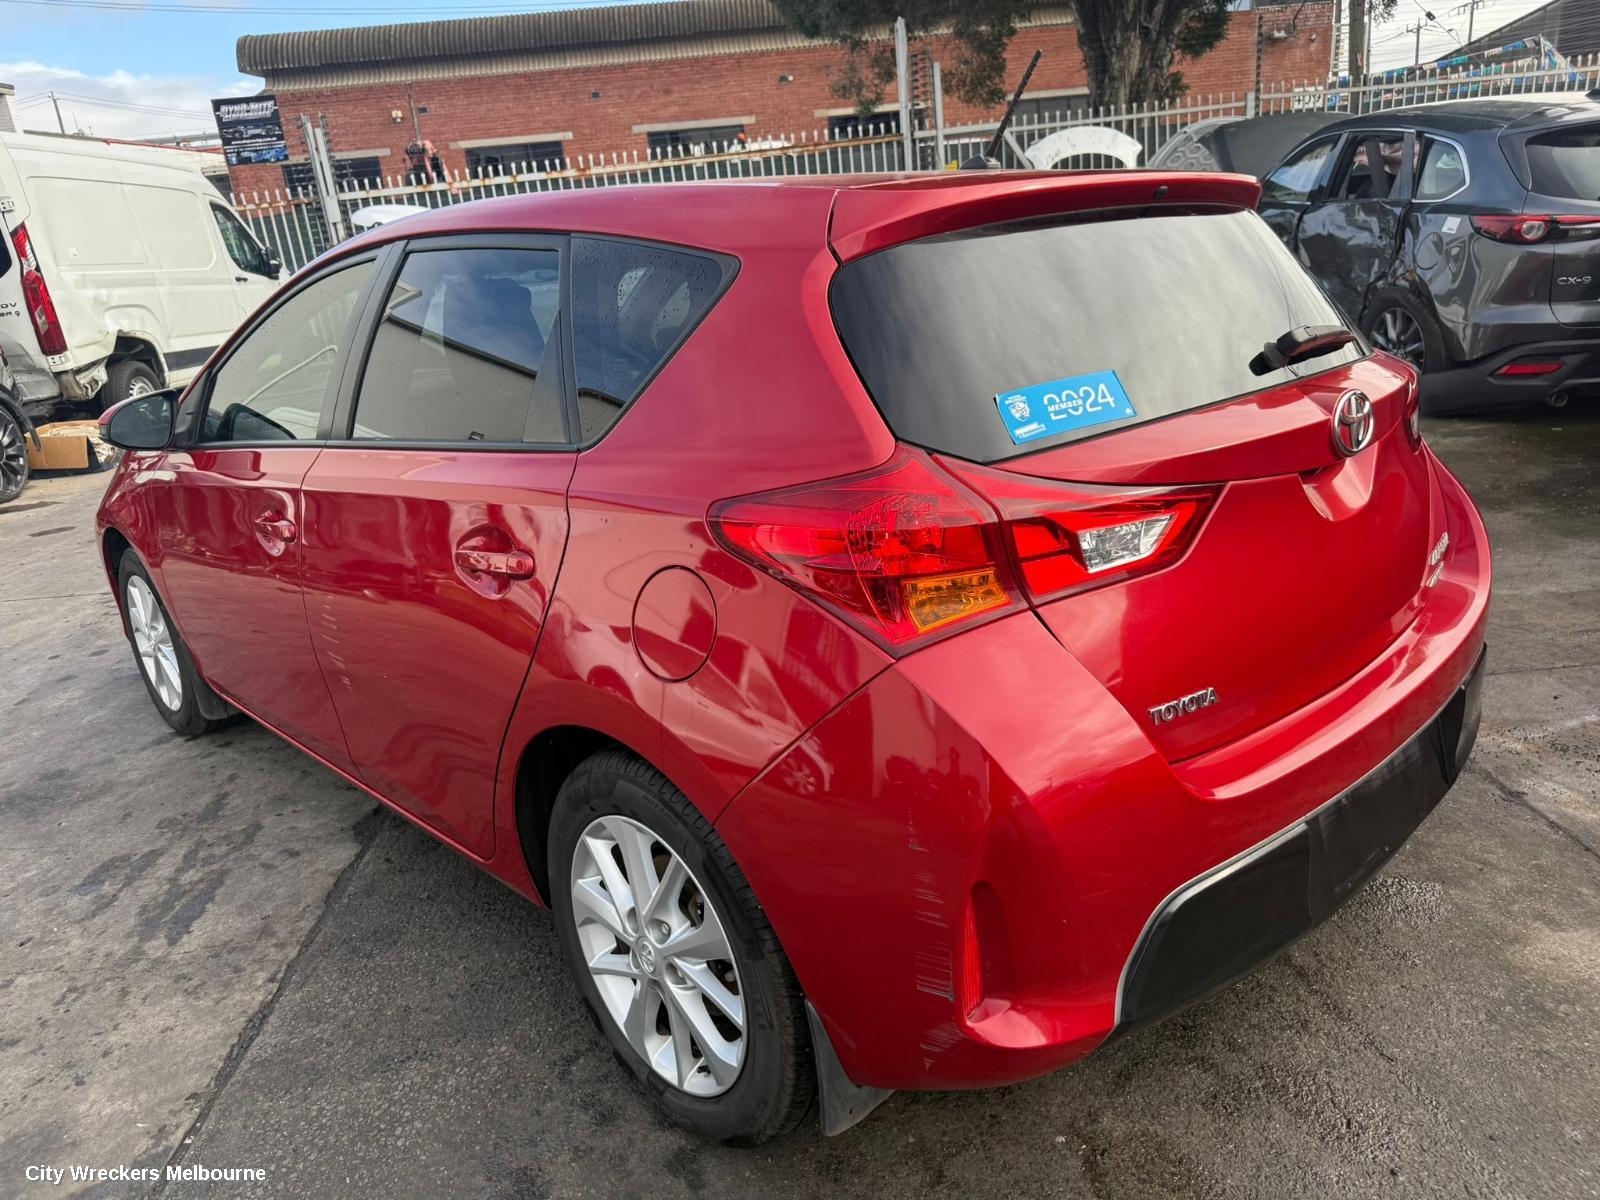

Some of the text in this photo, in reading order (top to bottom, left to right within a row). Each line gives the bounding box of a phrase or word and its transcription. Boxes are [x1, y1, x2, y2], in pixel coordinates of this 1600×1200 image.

[1557, 276, 1592, 285] CX-9
[1043, 383, 1115, 421] 2024
[1047, 399, 1083, 413] MEMBER
[1147, 687, 1216, 726] TOYOTA
